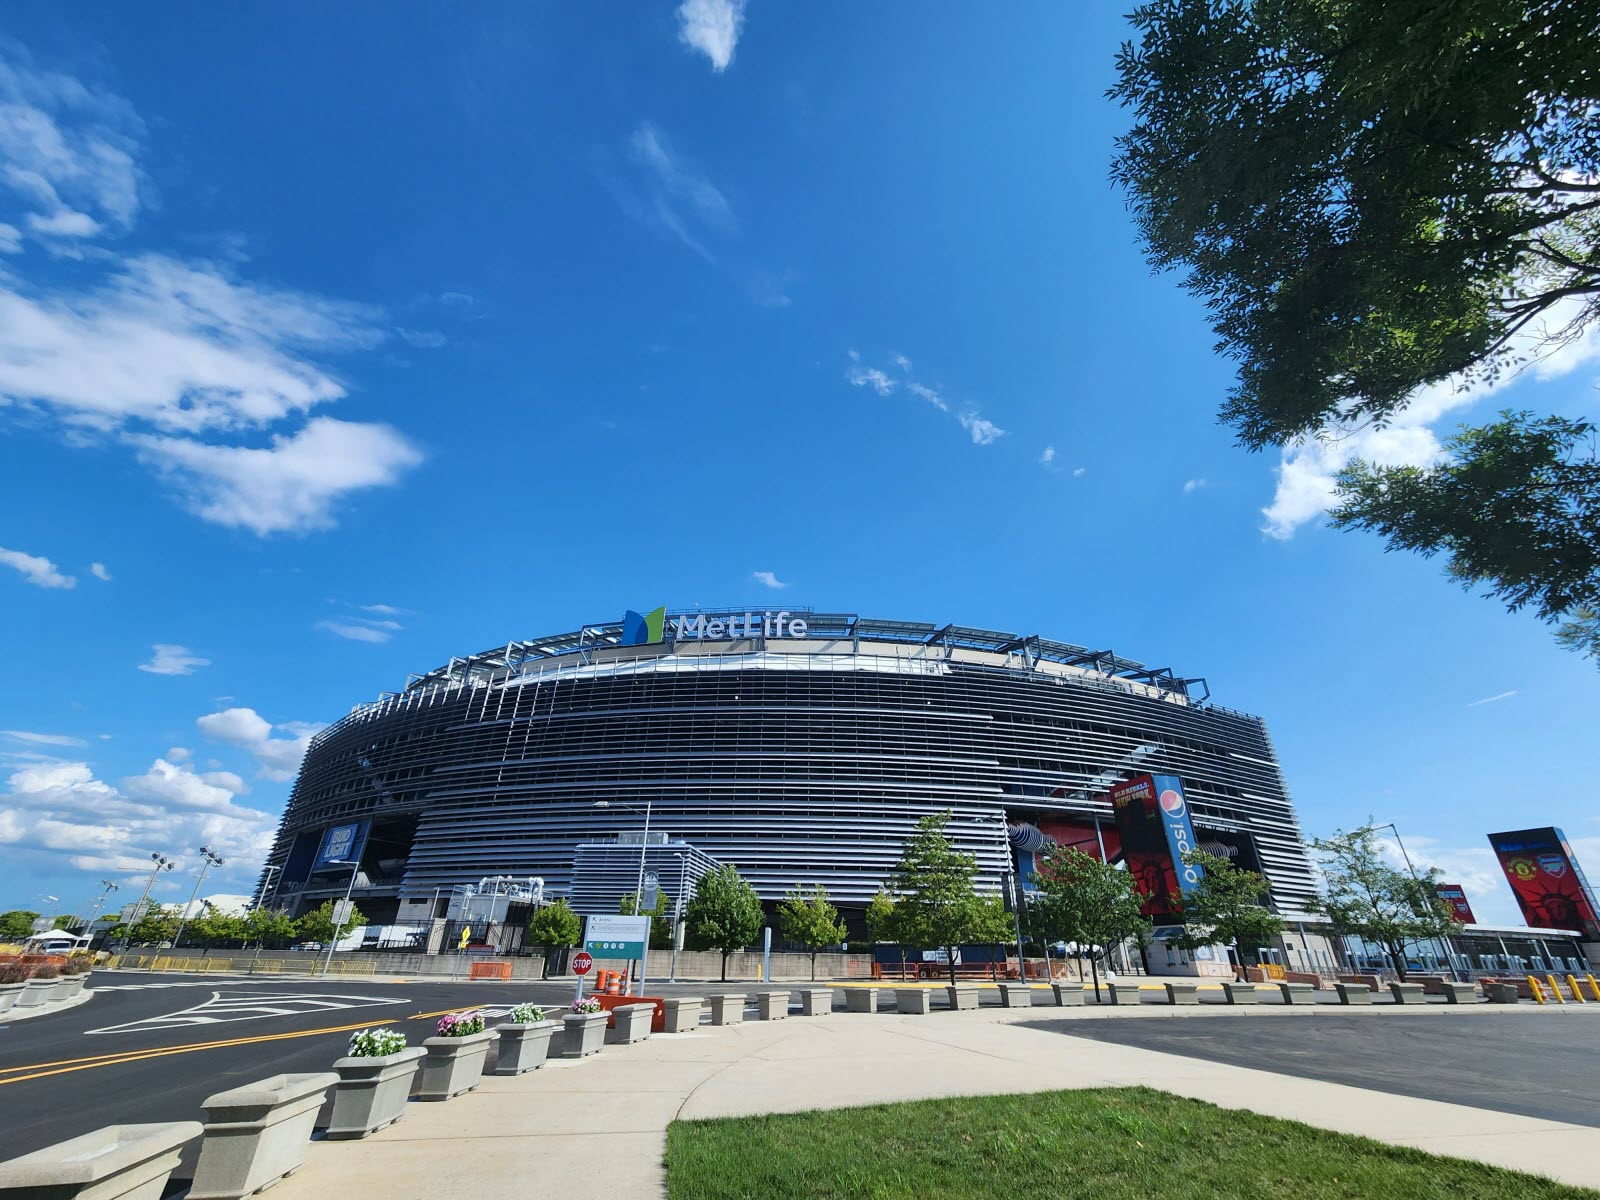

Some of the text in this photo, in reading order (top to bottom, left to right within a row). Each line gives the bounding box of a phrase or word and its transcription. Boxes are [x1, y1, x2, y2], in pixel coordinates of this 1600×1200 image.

[676, 611, 808, 640] MetLife
[331, 829, 352, 844] BUD
[324, 842, 351, 858] LIGHT
[573, 959, 592, 969] STOP
